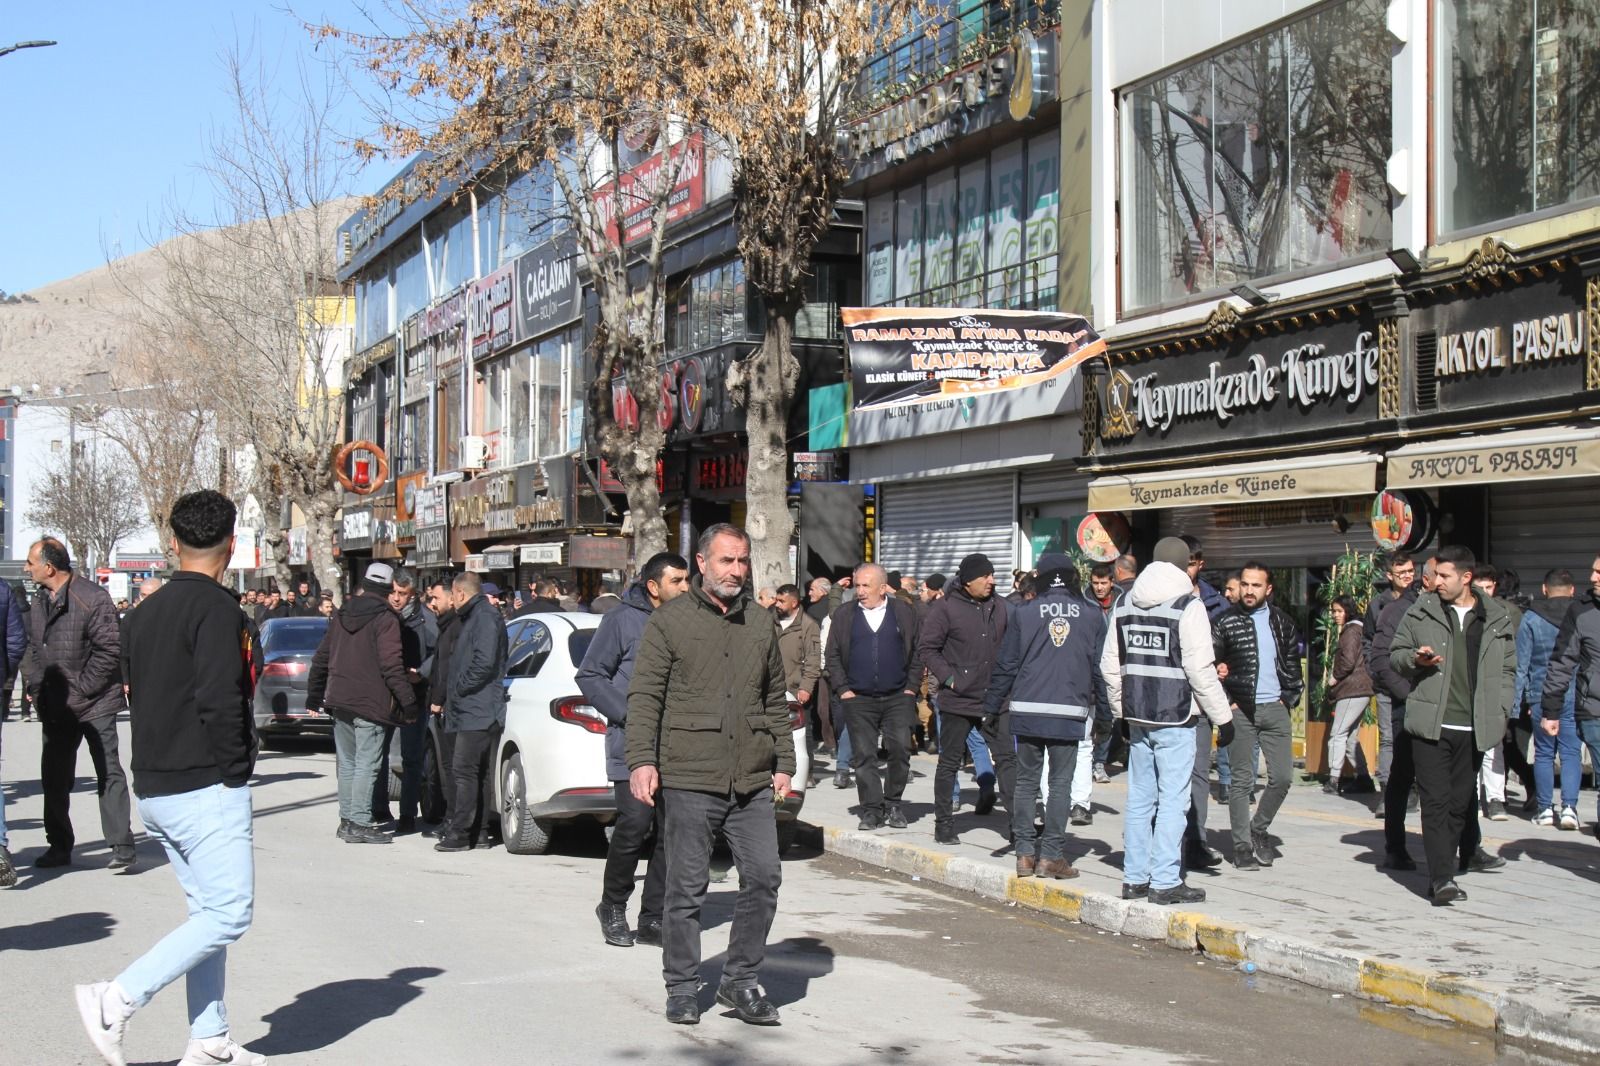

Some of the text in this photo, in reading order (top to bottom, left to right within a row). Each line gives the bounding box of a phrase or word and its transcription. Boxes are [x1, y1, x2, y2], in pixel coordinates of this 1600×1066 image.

[633, 161, 666, 209] SÜRÜC
[526, 255, 571, 312] ÇAĞLAYAN
[852, 328, 956, 341] RAMAZAN
[961, 328, 1022, 341] AYINA
[912, 340, 1038, 353] Kaymakzade Künefe'de
[911, 352, 1045, 370] KAMPANYA
[1434, 327, 1507, 377] AKYOL
[865, 371, 895, 383] KLASİK
[897, 370, 927, 381] KÜNEFE
[935, 368, 980, 379] DONDURMA
[1133, 331, 1379, 431] Kaymakzade Künefe
[1409, 446, 1577, 479] AKYOL PASAJI
[1130, 474, 1296, 505] Kaymakzade Künefe
[1040, 603, 1080, 618] POLIS
[1128, 632, 1162, 647] POLİS
